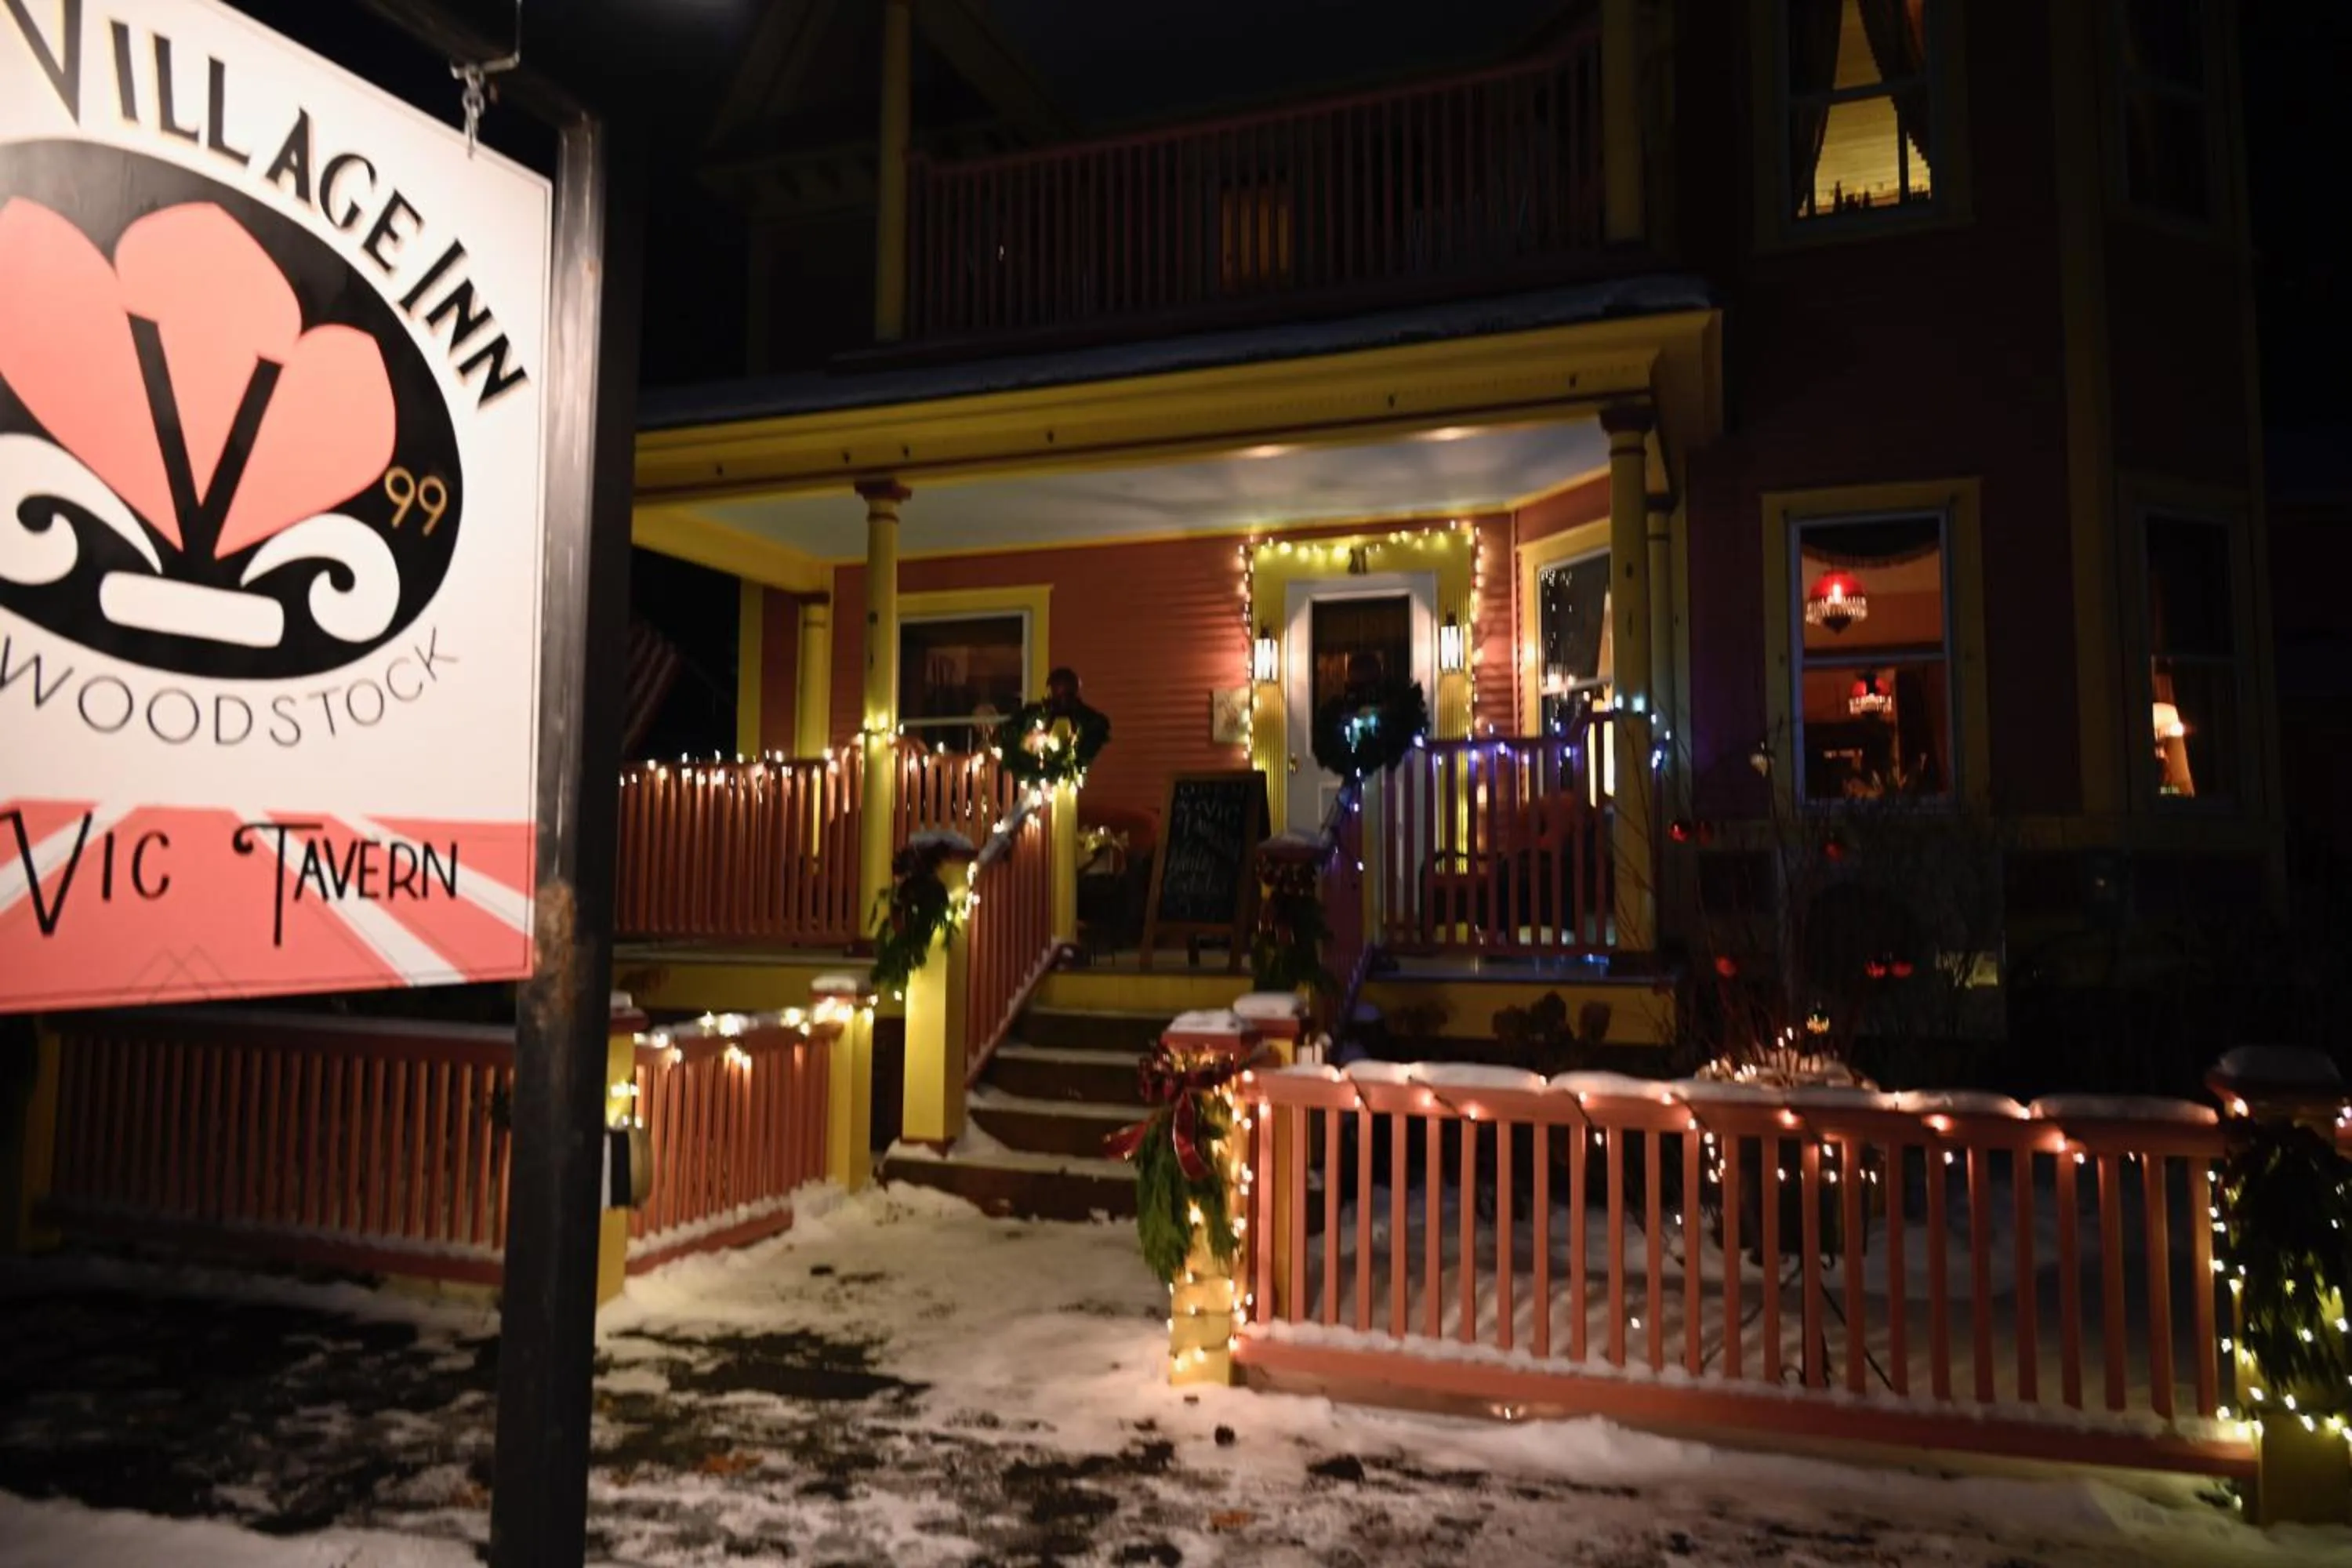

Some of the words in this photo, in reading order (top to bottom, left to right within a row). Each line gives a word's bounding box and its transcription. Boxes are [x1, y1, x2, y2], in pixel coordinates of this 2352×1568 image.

[2, 0, 424, 273] VILLAGE
[399, 238, 530, 408] INN
[384, 466, 448, 536] 99
[0, 627, 459, 747] WOODSTOCK
[0, 808, 170, 938] VIC
[233, 823, 458, 947] TAVERN
